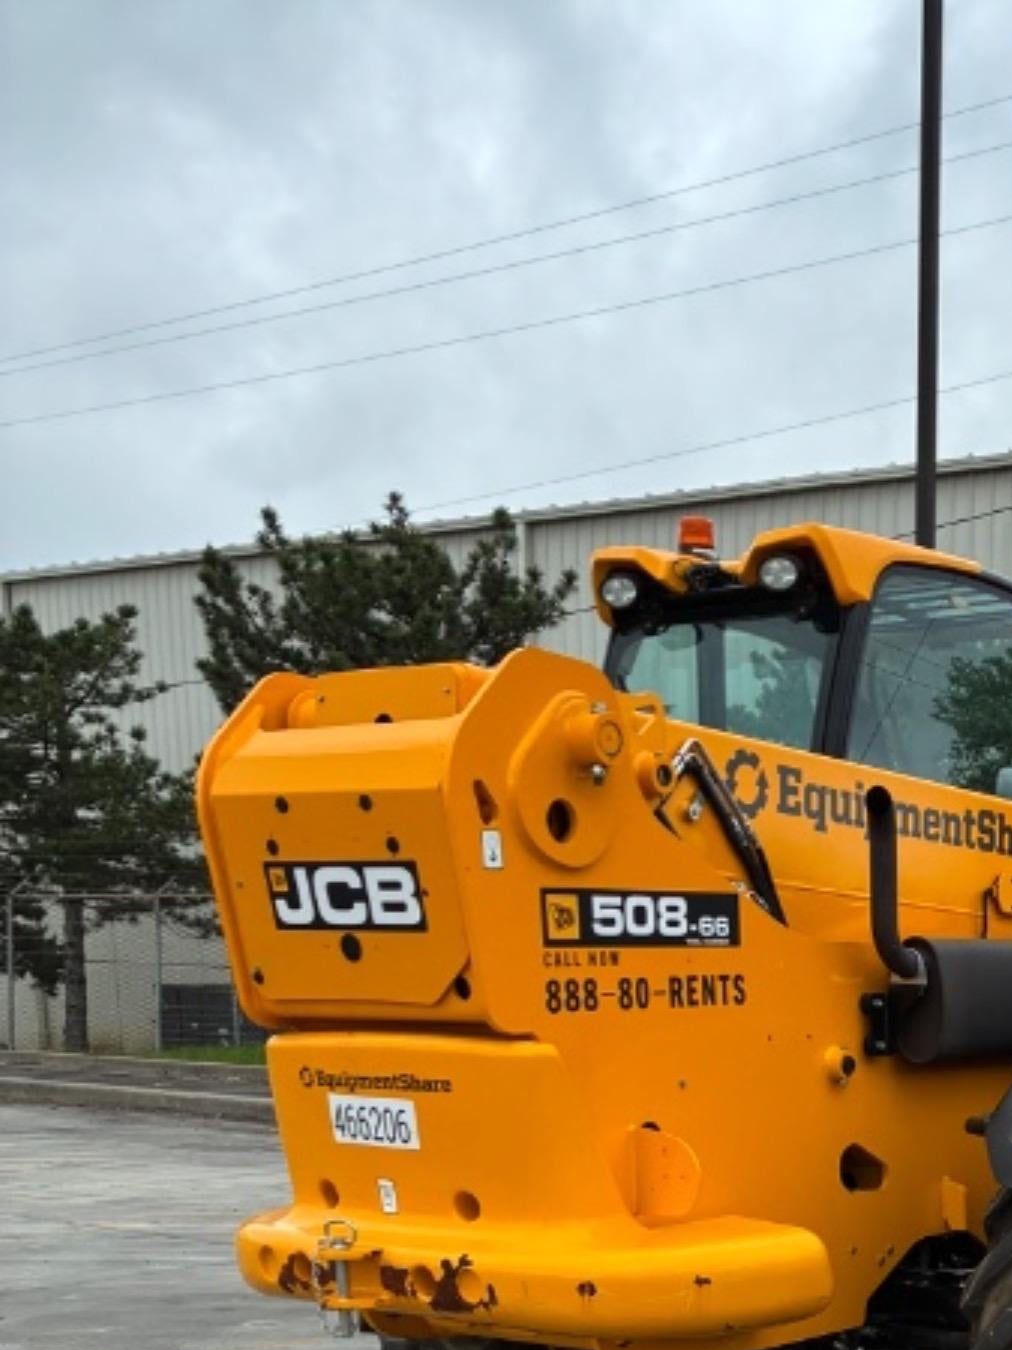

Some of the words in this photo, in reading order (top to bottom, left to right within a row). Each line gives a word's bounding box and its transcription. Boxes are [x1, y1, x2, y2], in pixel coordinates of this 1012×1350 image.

[274, 866, 422, 926] JCB
[543, 951, 581, 968] CALL
[587, 951, 620, 968] NOW
[545, 974, 747, 1014] 888-80-RENTS
[314, 1069, 454, 1093] EquipmentShare
[334, 1103, 412, 1144] 466206
